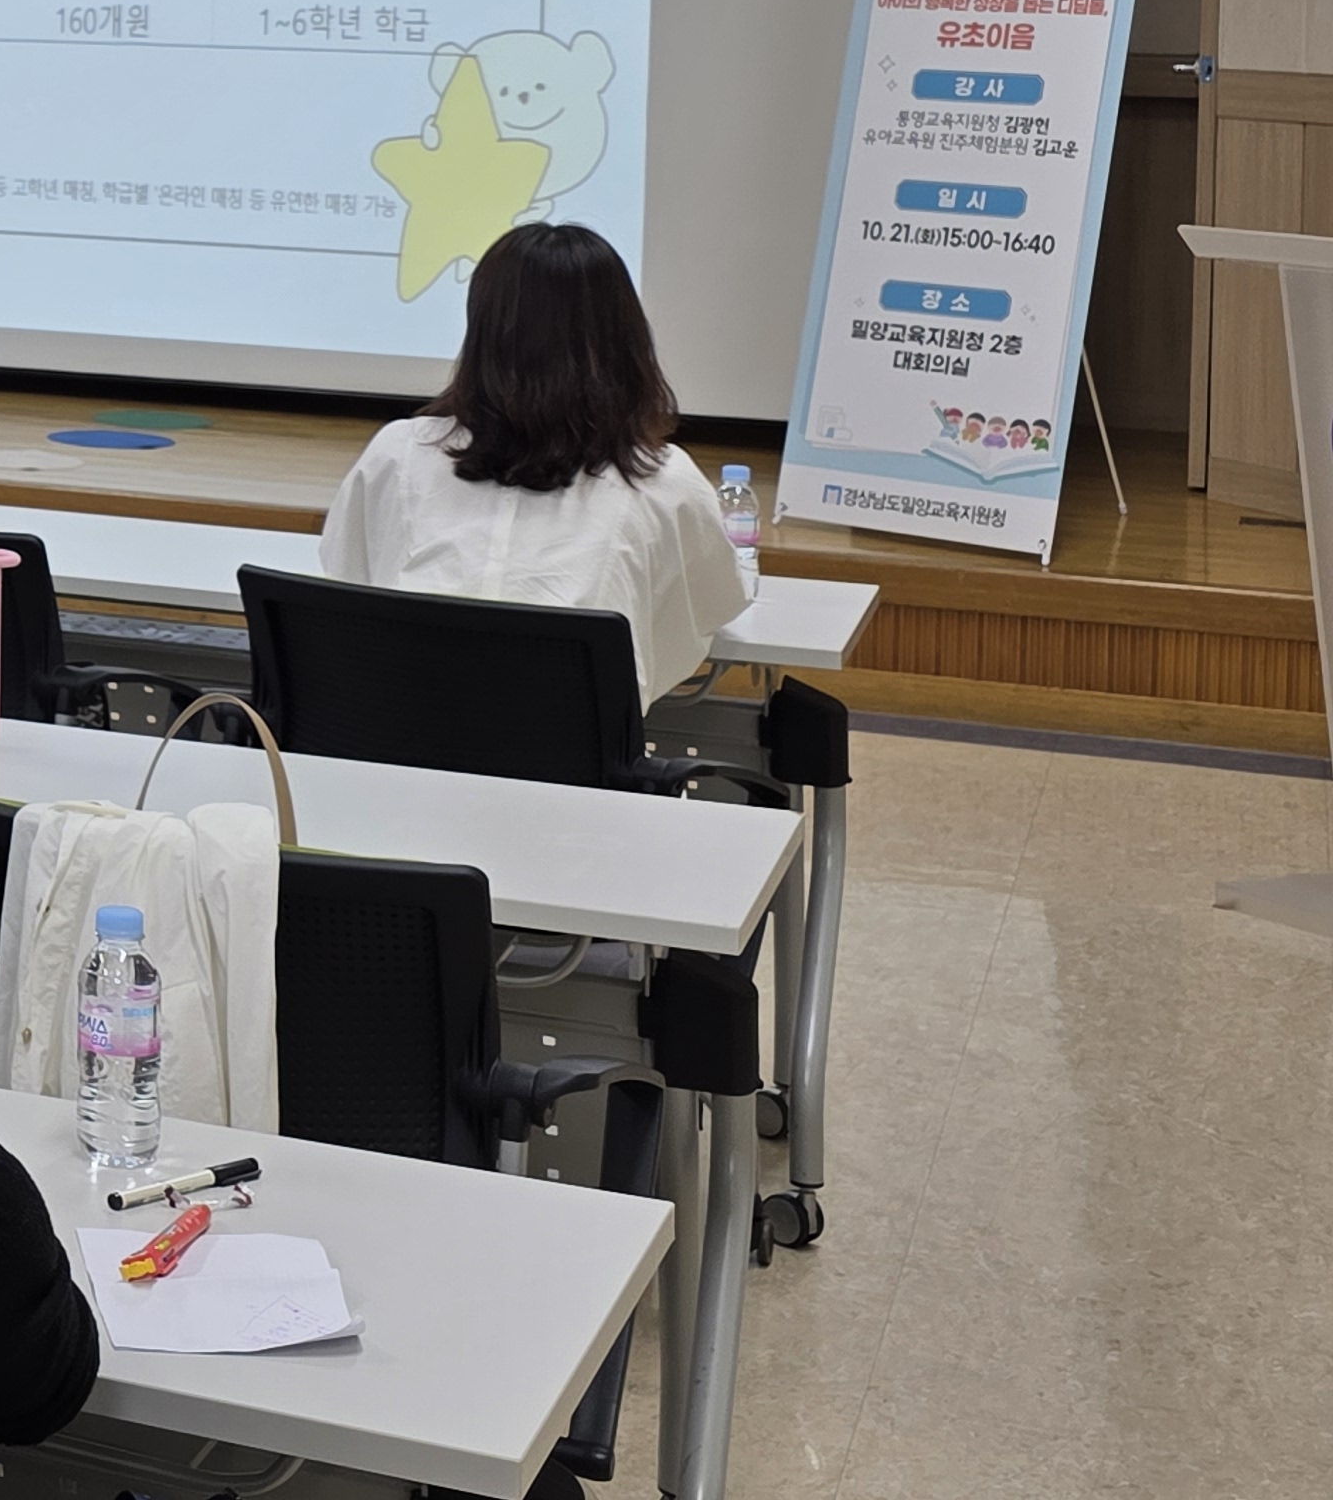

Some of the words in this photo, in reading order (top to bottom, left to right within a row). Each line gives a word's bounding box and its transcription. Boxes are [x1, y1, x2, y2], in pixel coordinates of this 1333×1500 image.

[55, 5, 150, 39] 160개원
[258, 7, 362, 40] 1~6학년
[374, 7, 430, 43] 학급
[937, 21, 1035, 50] 유초이음
[850, 320, 985, 352] 밀양교육지원청
[990, 334, 1023, 356] 2층
[892, 350, 972, 377] 대회의실
[843, 488, 1007, 528] 경상남도밀양교육지원청
